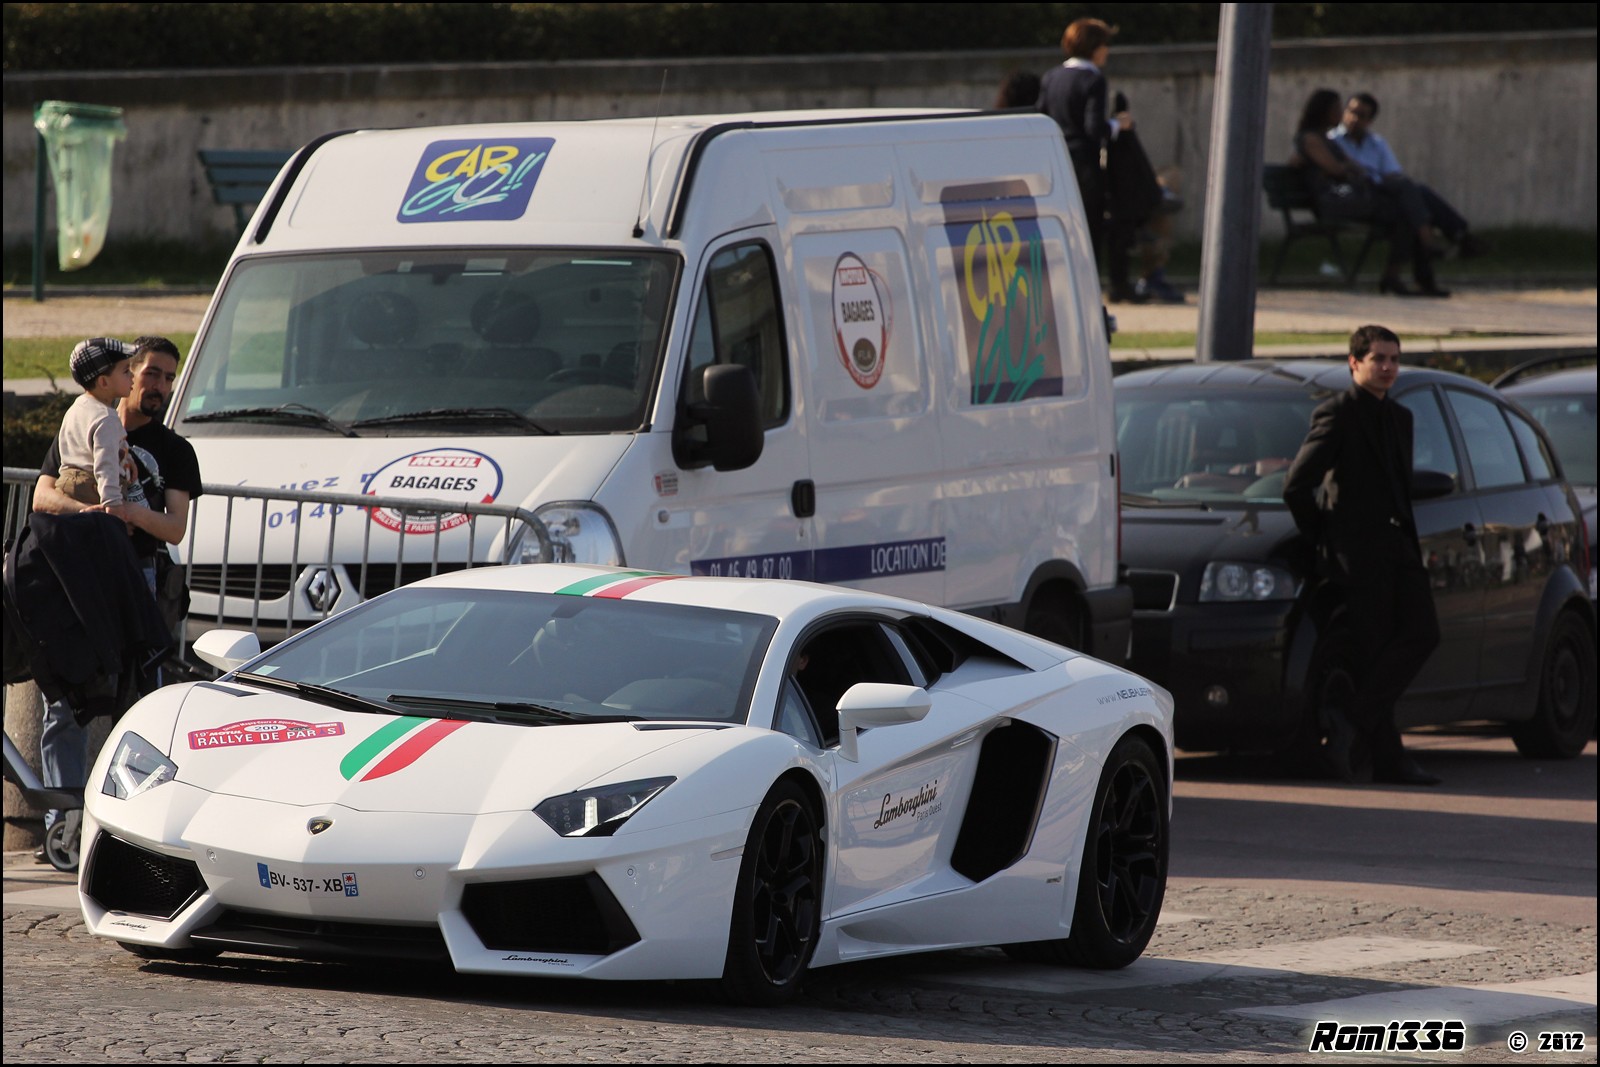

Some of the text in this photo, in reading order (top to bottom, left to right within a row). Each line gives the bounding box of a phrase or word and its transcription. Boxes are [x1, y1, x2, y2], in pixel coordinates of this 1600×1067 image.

[424, 144, 519, 183] CAR
[964, 206, 1028, 322] CAR
[841, 299, 875, 323] BAGAGES
[411, 457, 479, 467] MOTUL
[390, 475, 477, 491] BAGAGES
[871, 544, 929, 573] LOCATION
[197, 732, 254, 747] RALLYE
[260, 732, 280, 742] DE
[873, 779, 938, 830] Lamborghini
[345, 885, 357, 896] 75
[501, 954, 569, 964] Lamborghini
